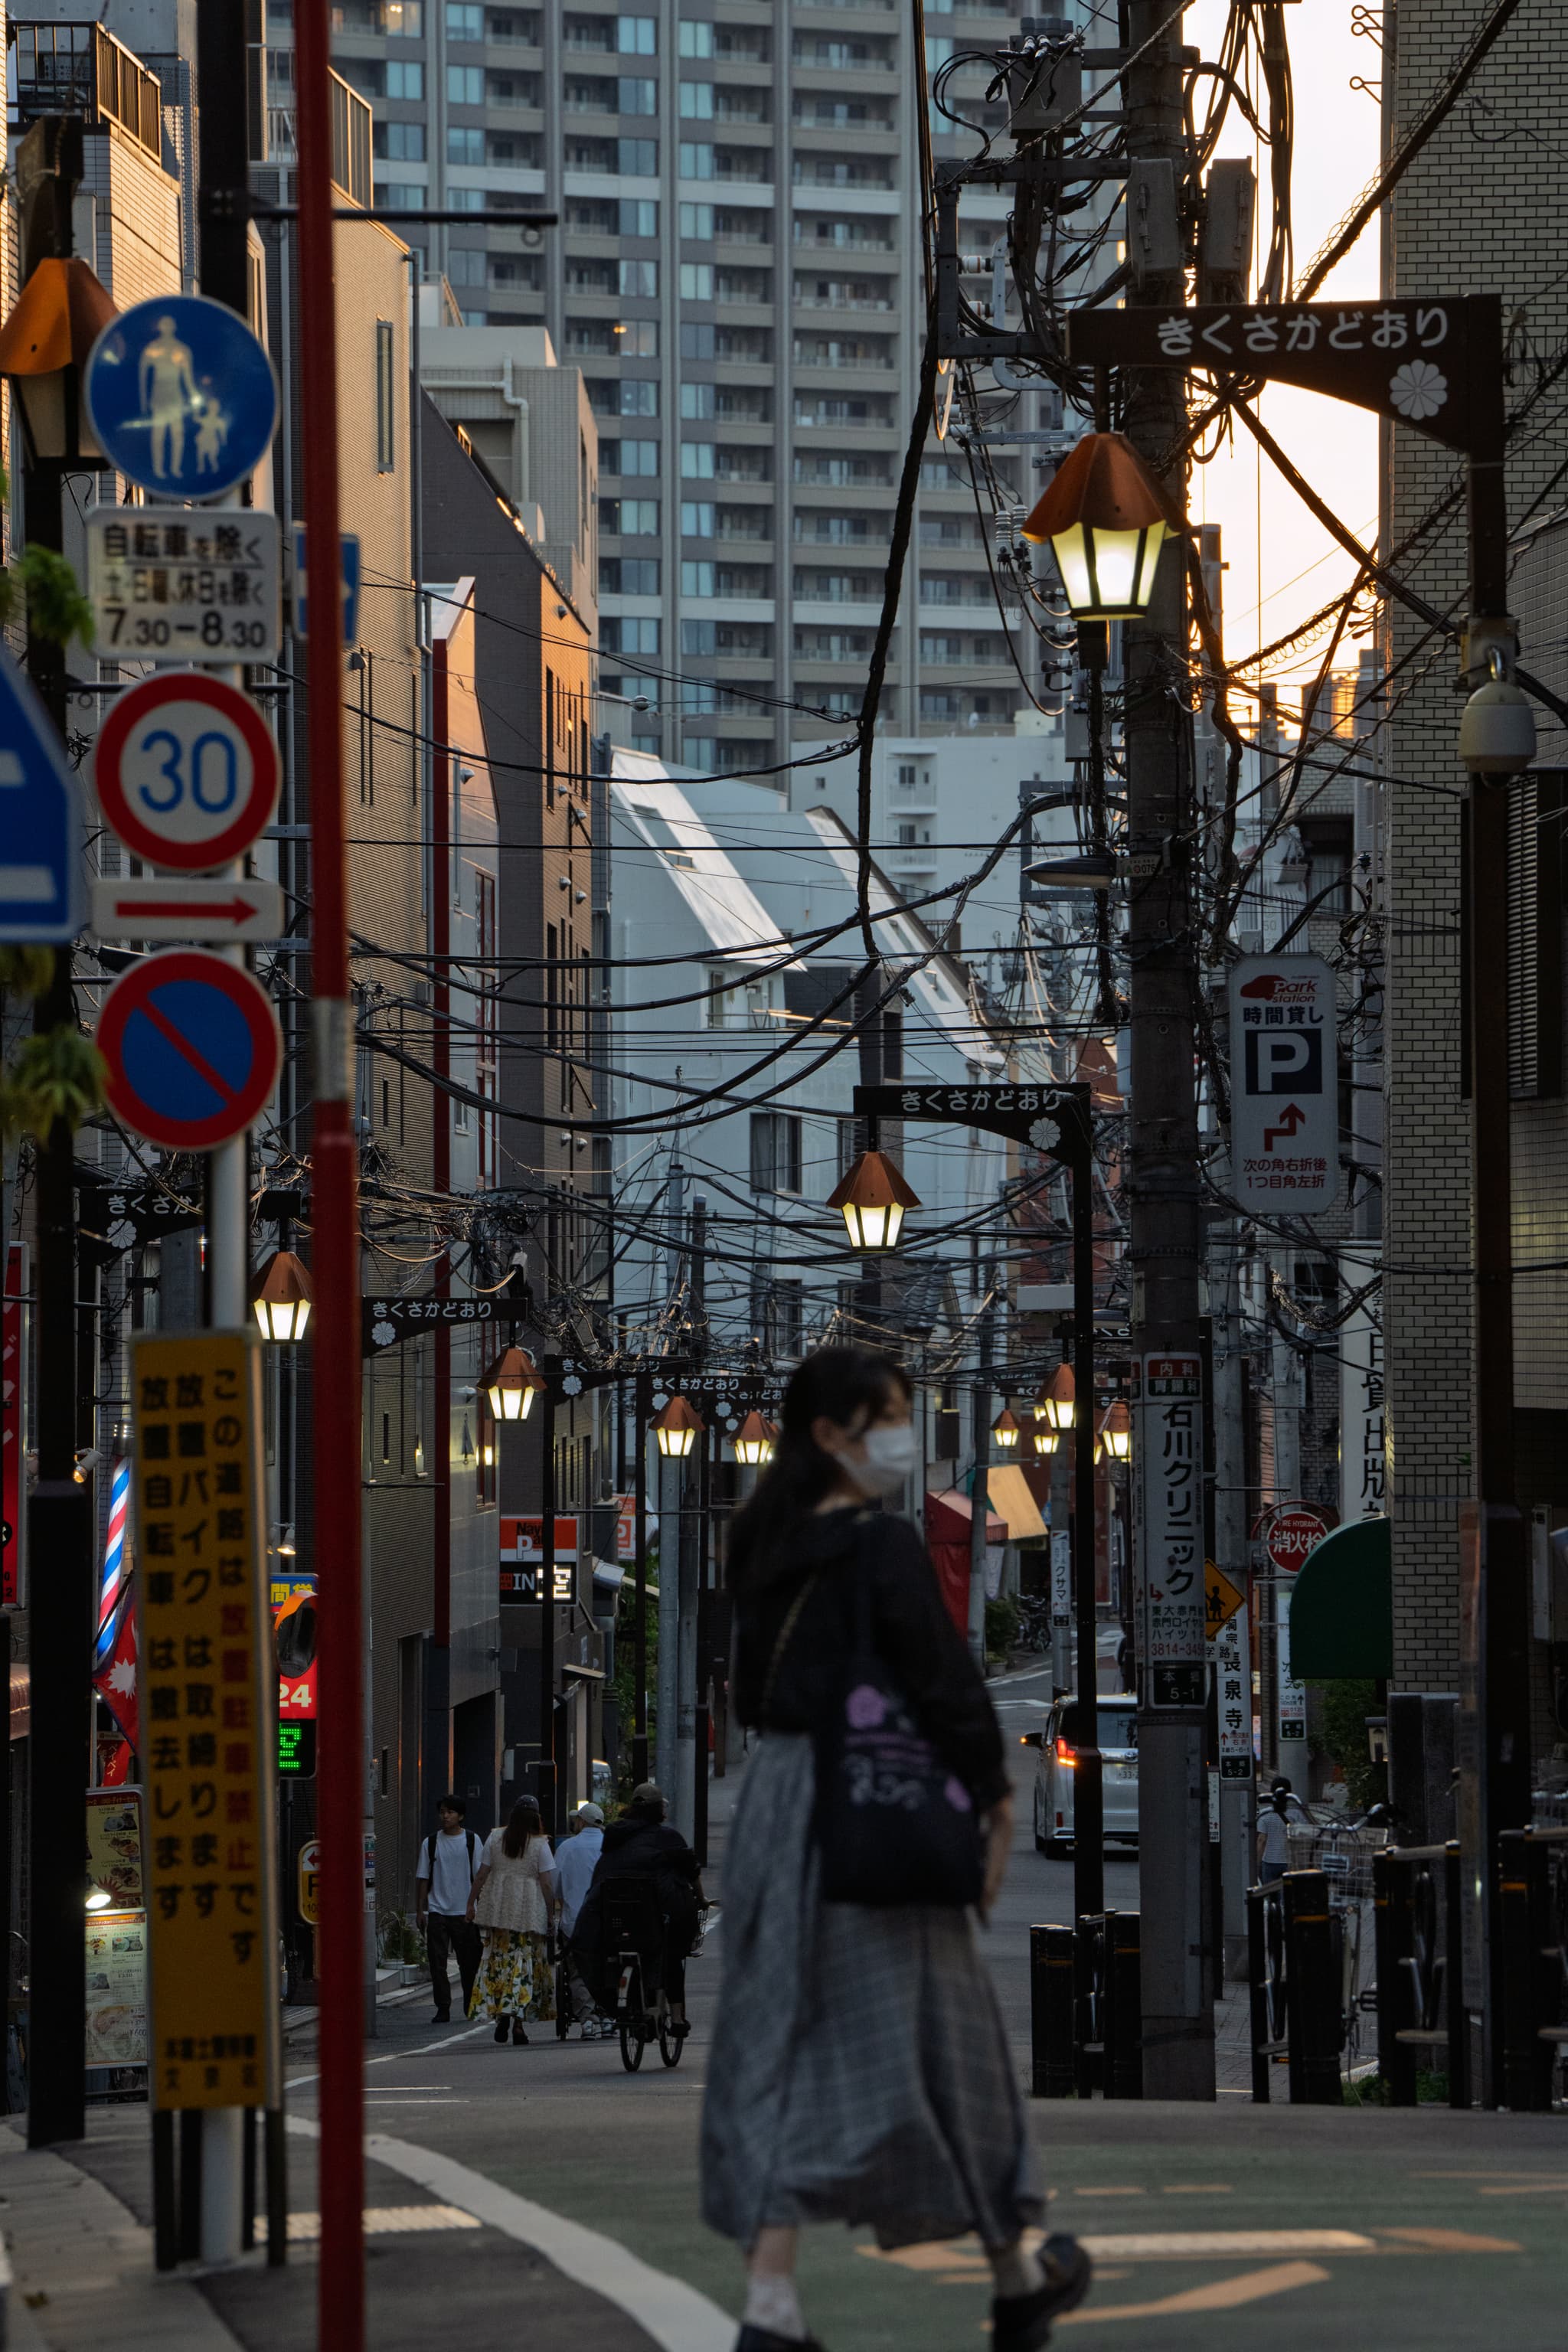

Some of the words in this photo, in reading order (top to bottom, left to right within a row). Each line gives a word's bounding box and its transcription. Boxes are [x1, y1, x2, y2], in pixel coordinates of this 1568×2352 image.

[1158, 307, 1448, 355] きくさかどおり
[104, 522, 262, 561] 自転車を除く
[139, 730, 238, 813] 30
[1273, 980, 1318, 993] Park
[1272, 995, 1316, 1004] station
[1243, 1006, 1324, 1025] 時間貸し
[1257, 1032, 1310, 1092] P
[901, 1089, 1060, 1112] きくさかどおり
[1243, 1158, 1328, 1172] 次の角右折後
[1246, 1174, 1325, 1189] 1つ目角左折
[372, 1302, 492, 1318] きくさかどおり
[1159, 1361, 1194, 1377] 内科
[652, 1378, 740, 1390] きくさかどおり
[1161, 1402, 1194, 1596] 石川クリニック
[513, 1573, 535, 1590] IN
[1056, 1566, 1066, 1599] クサマ
[1162, 1671, 1200, 1684] 本郷
[1170, 1687, 1195, 1700] 5-1
[1224, 1651, 1242, 1729] 長泉寺
